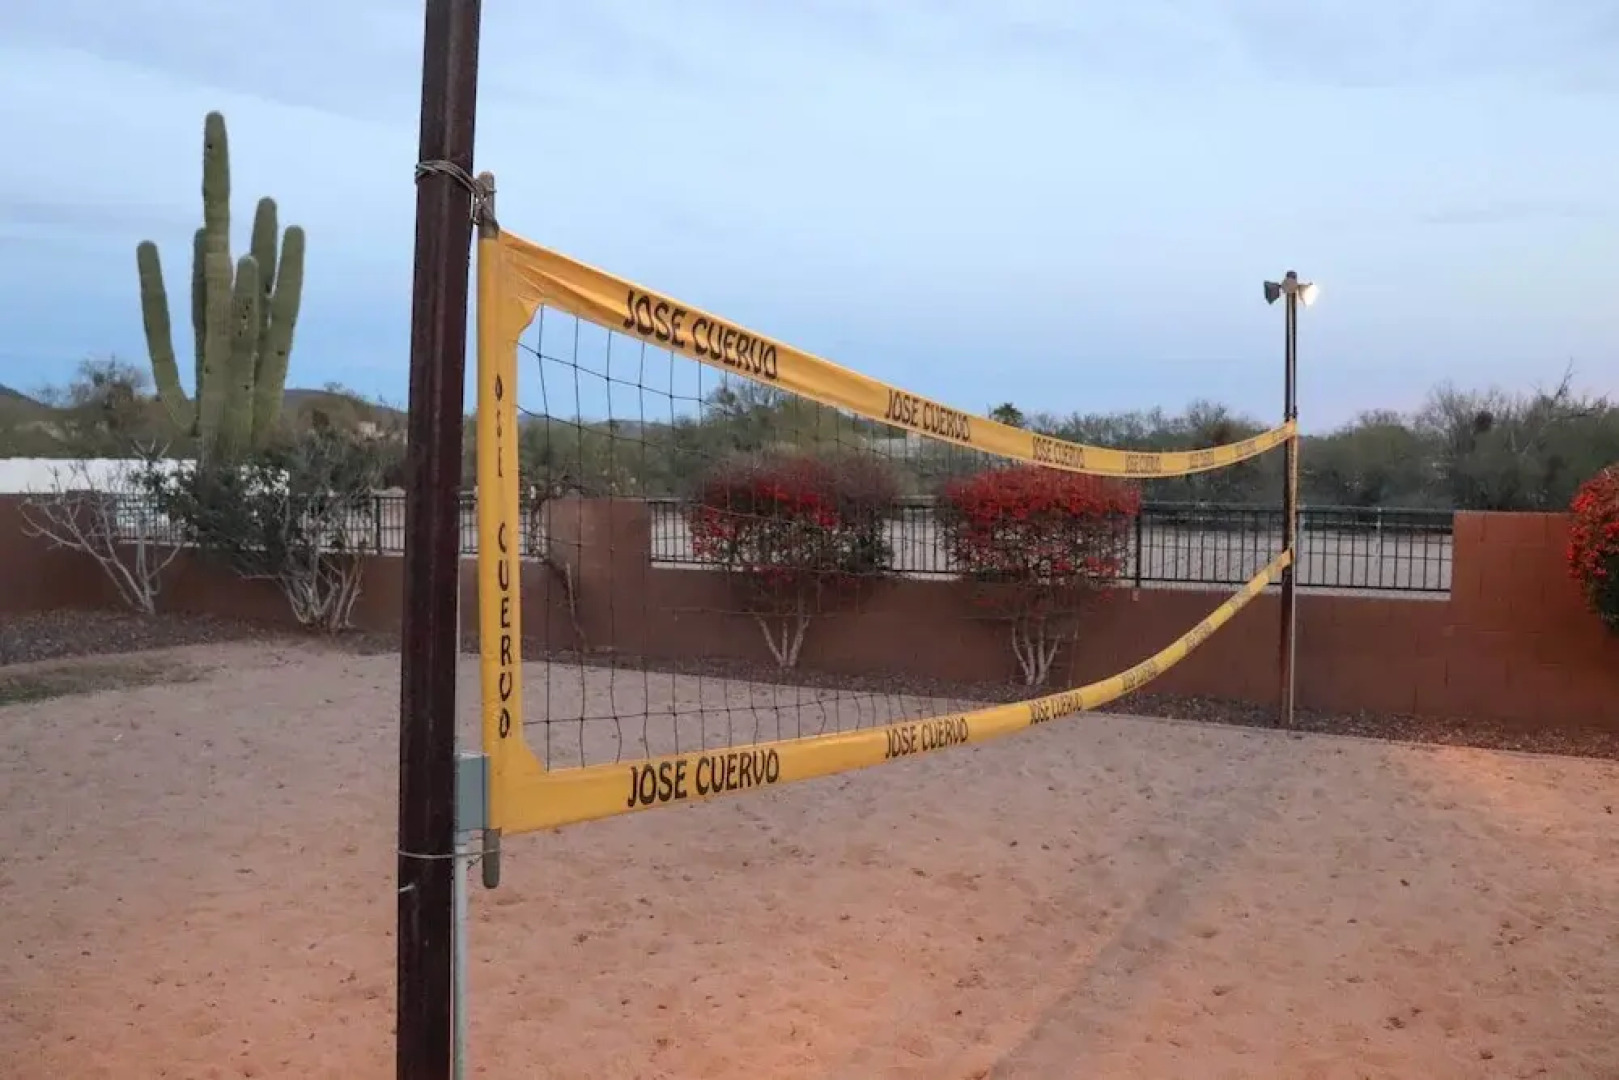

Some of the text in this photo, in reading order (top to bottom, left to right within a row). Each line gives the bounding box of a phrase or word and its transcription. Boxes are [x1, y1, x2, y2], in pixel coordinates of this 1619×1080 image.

[623, 289, 778, 379] JOSE CUERVO
[885, 388, 971, 442] JOSE CUERVO
[498, 522, 513, 739] CUERVO
[885, 716, 969, 759] JOSE CUERVO
[627, 748, 780, 808] JOSE CUERVO
